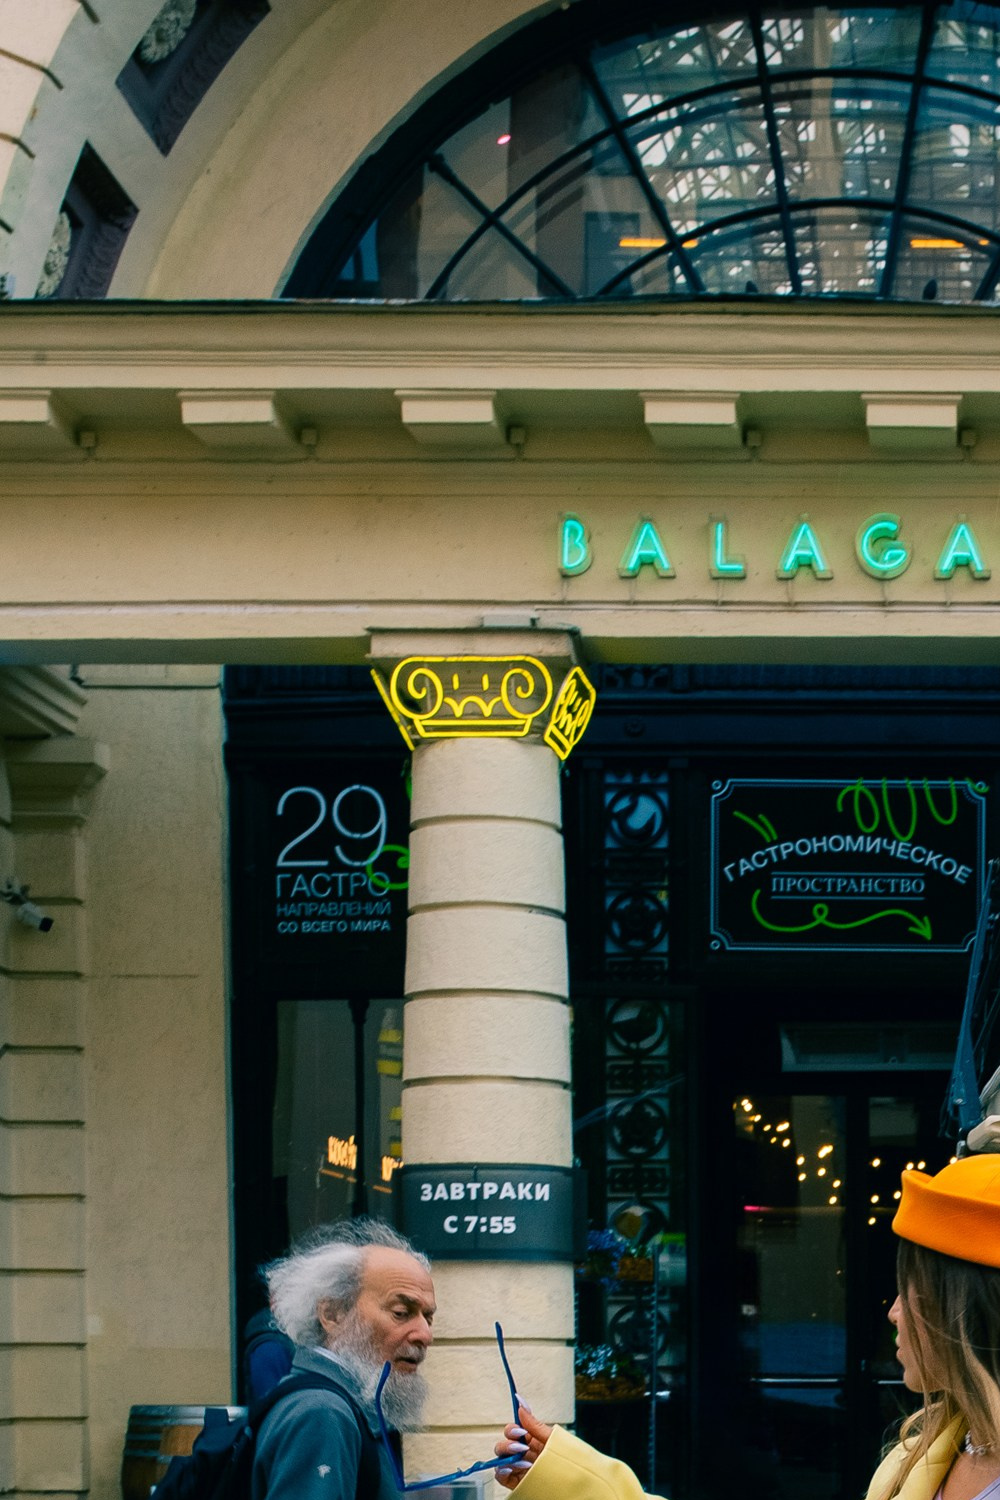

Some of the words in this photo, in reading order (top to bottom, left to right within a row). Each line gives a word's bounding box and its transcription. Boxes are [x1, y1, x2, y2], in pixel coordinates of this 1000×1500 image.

[276, 785, 388, 867] 29
[723, 834, 973, 885] ГАСТРОНОМИЧЕСКОЕ
[276, 872, 391, 898] ГАСТРО
[771, 876, 925, 894] ПРОСТРАНСТВО
[276, 899, 392, 917] НАПРАВЛЕНИЙ
[277, 920, 299, 934] СО
[301, 920, 348, 933] ВСЕГО
[350, 919, 391, 932] МИРА
[420, 1181, 551, 1202] ЗАВТРАКИ
[443, 1215, 458, 1234] С
[464, 1215, 517, 1234] 7:55
